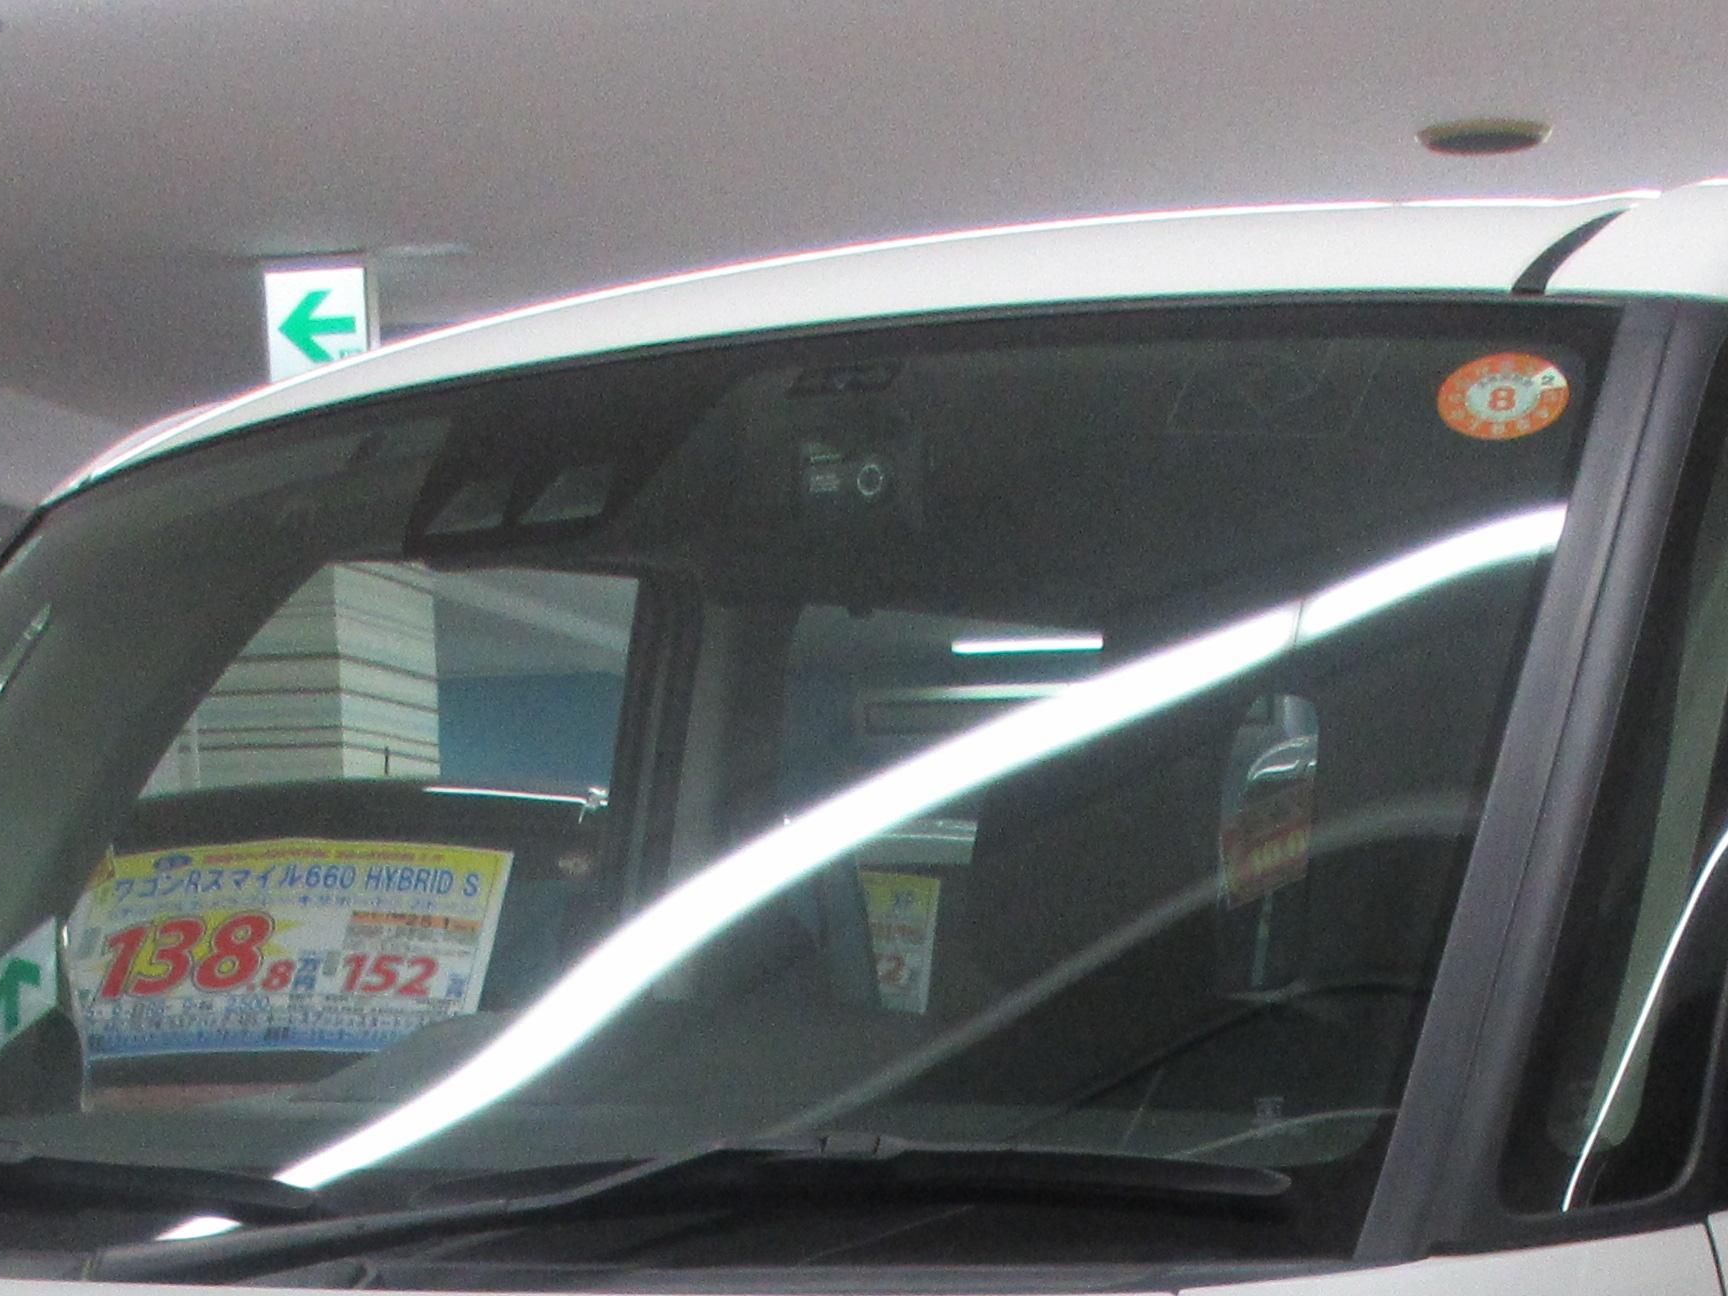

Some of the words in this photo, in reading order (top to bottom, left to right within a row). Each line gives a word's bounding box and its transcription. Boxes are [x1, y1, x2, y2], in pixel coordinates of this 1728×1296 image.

[364, 866, 455, 896] HYBRID
[463, 872, 480, 898] S
[341, 953, 440, 997] 152
